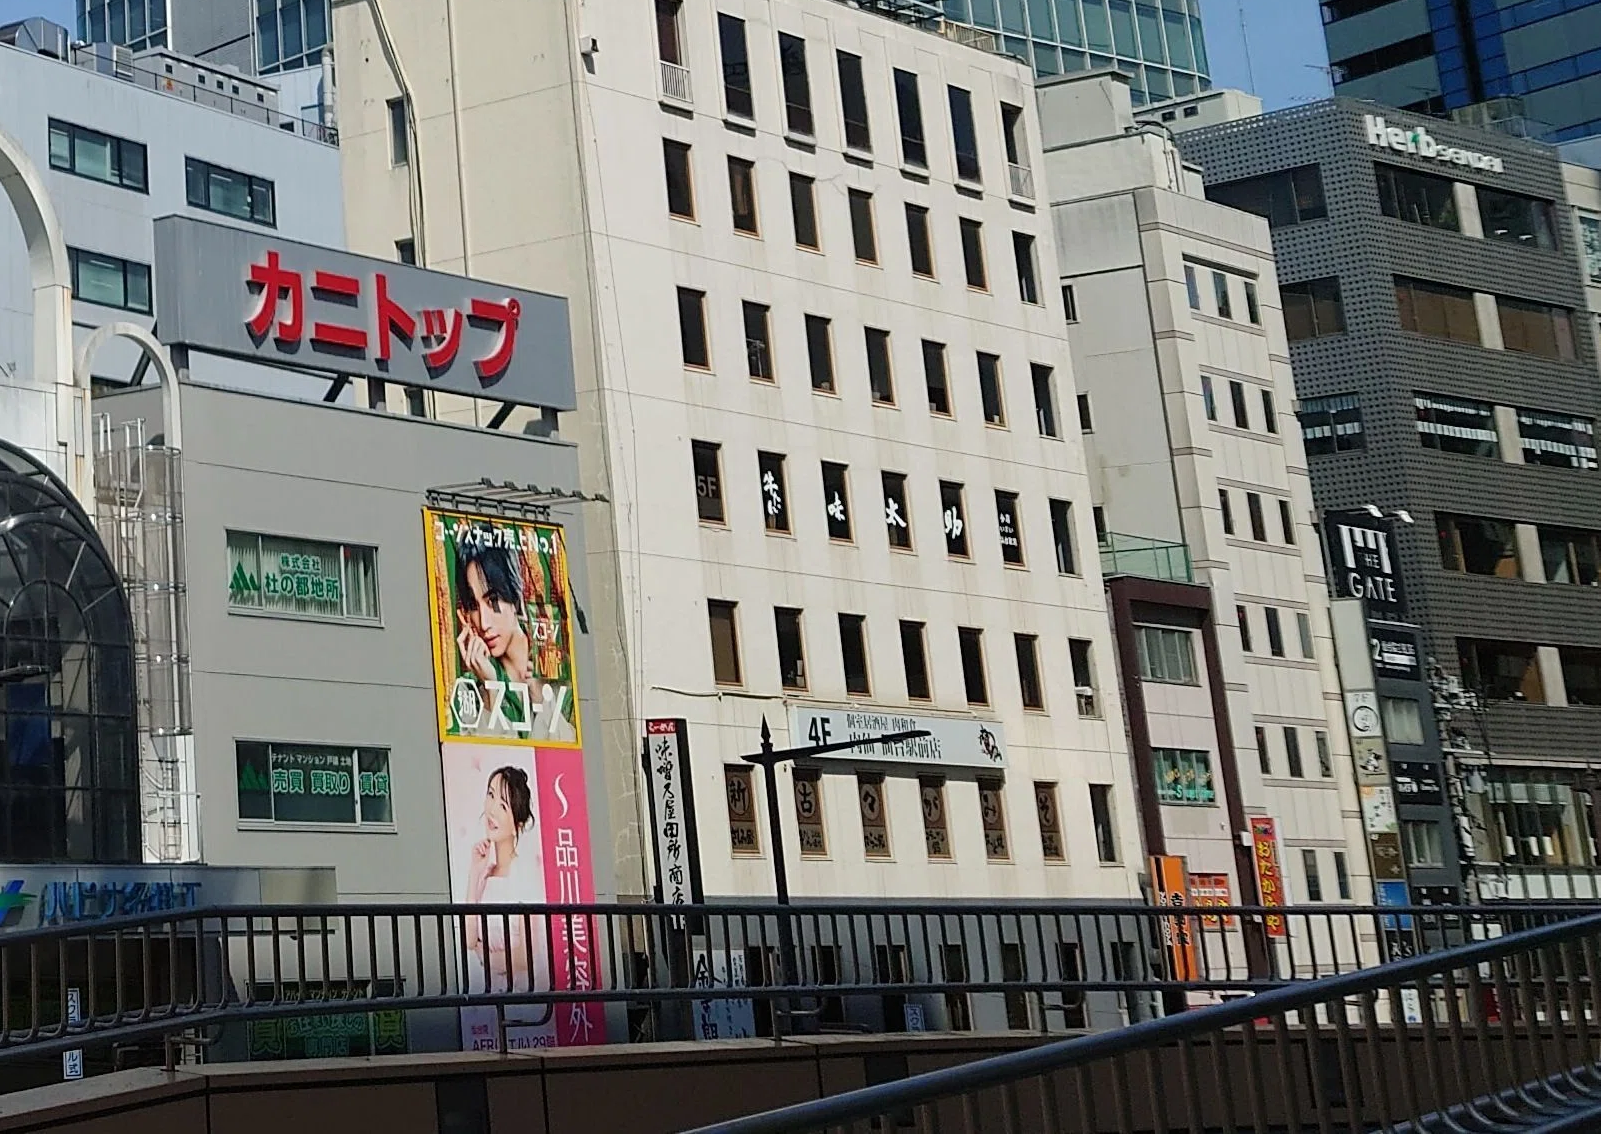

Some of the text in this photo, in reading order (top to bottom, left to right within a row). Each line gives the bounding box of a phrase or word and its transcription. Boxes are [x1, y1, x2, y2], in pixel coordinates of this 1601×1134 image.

[246, 250, 521, 384] カニトップ
[697, 475, 717, 497] 5F
[280, 552, 322, 572] 株式会社
[264, 572, 340, 600] 杜の都地所
[1348, 571, 1398, 603] GATE
[484, 679, 568, 734] スコーン
[648, 721, 677, 733] らーめん
[808, 716, 832, 746] 4F
[846, 713, 889, 732] 個室居酒屋
[272, 768, 389, 796] 売買 買取り 賃貸
